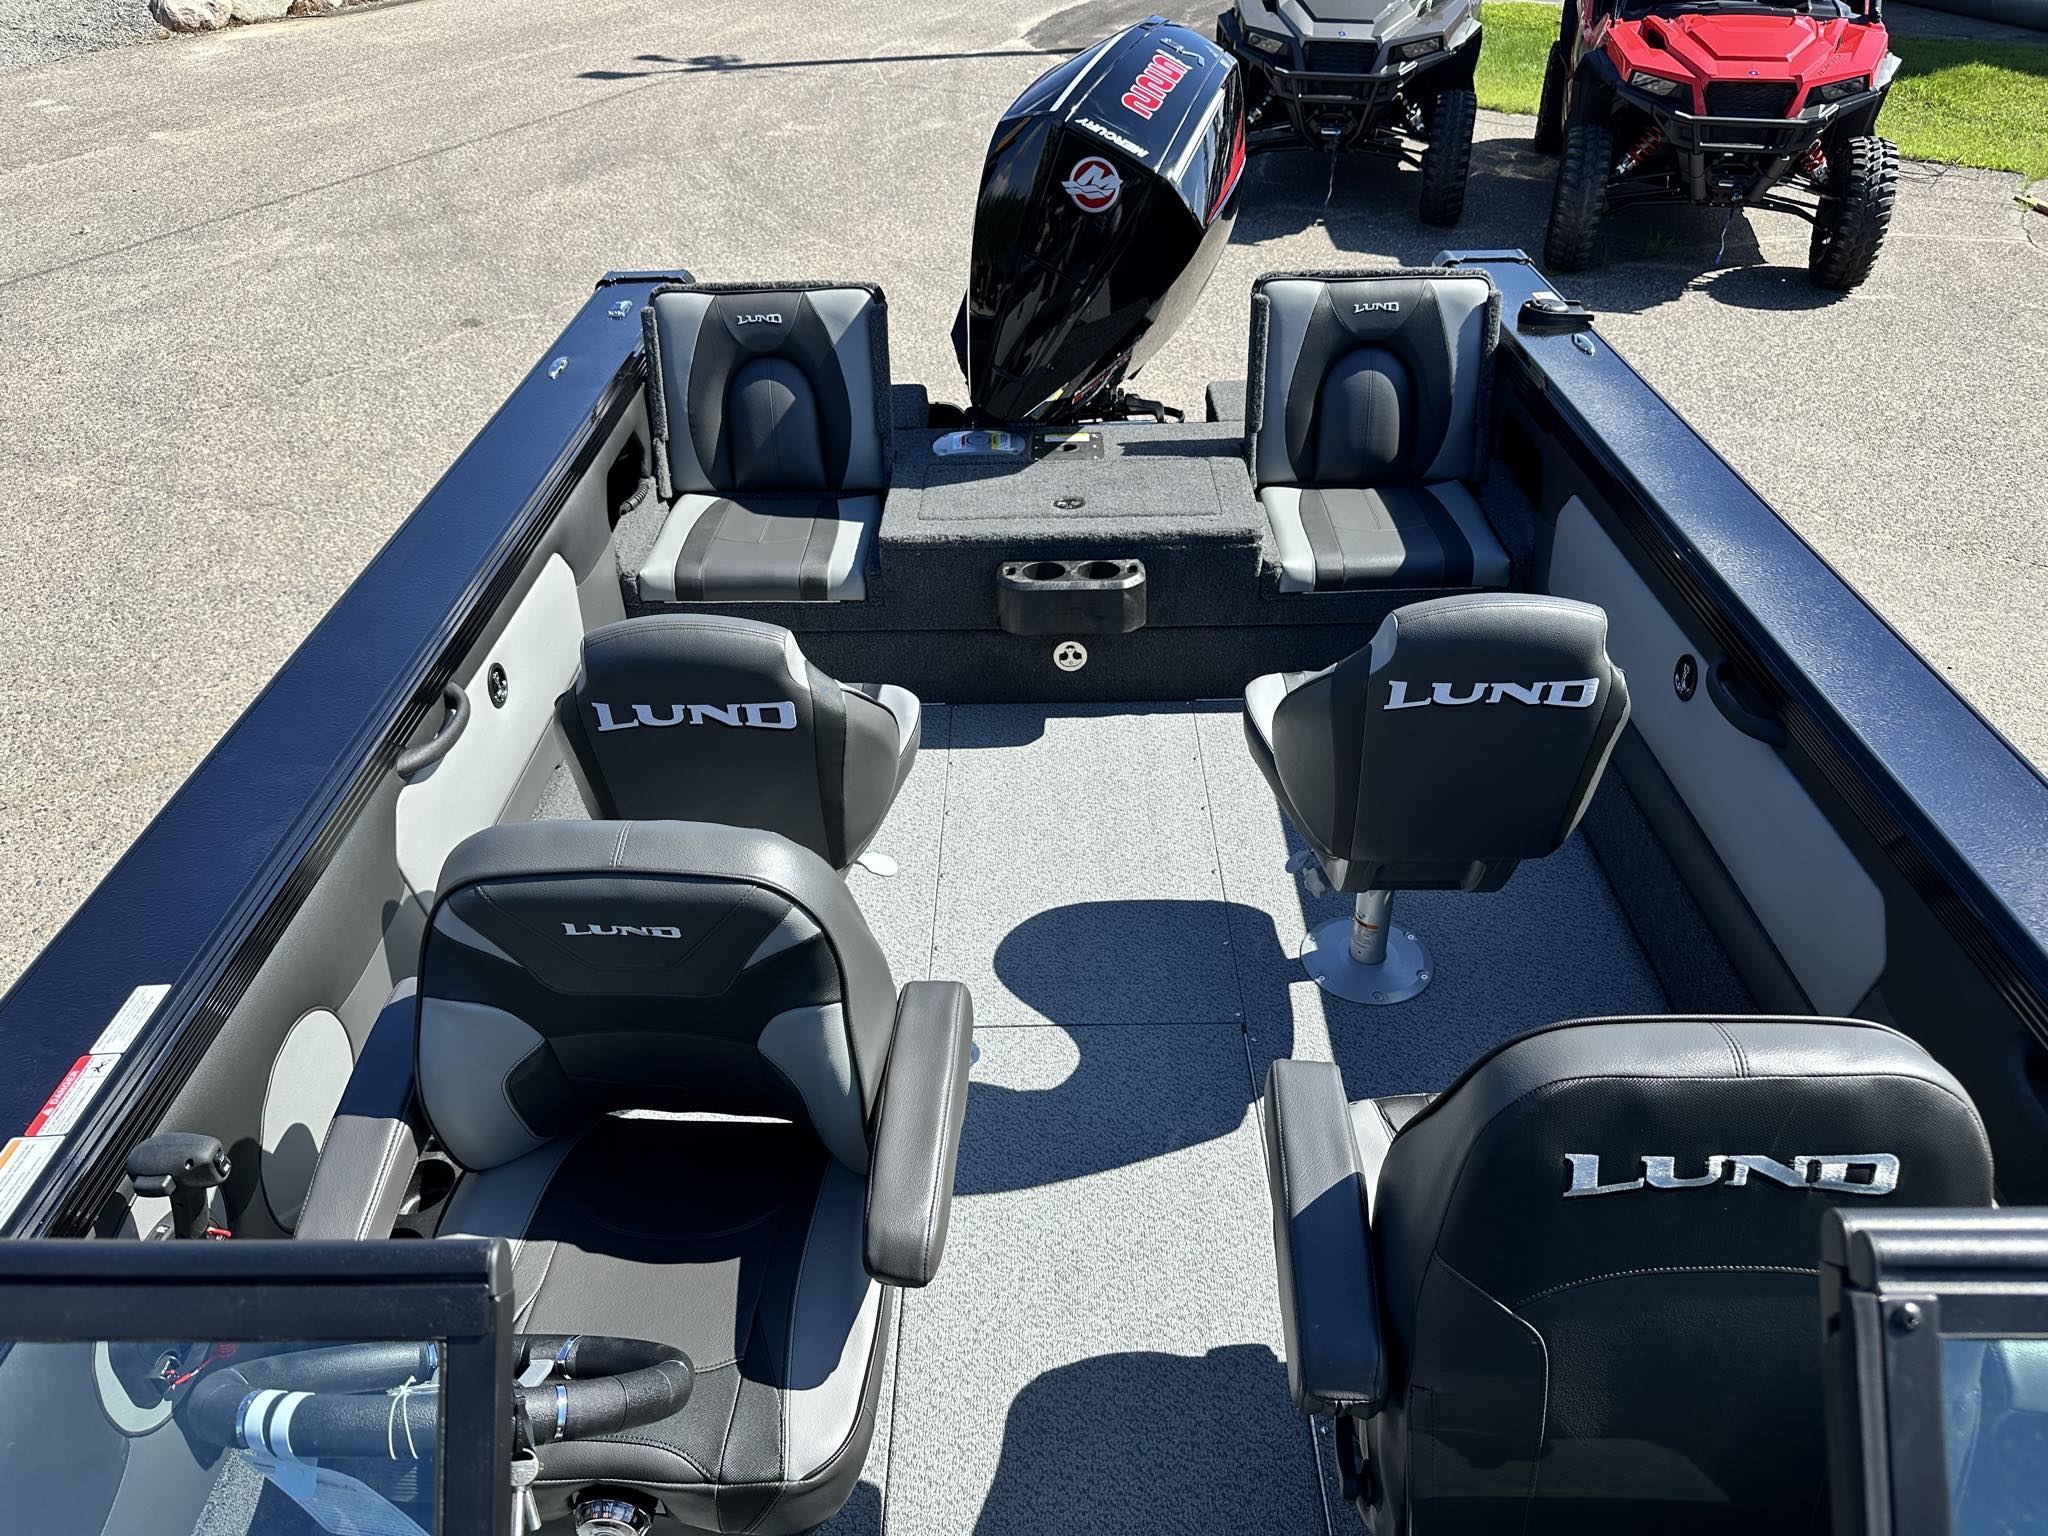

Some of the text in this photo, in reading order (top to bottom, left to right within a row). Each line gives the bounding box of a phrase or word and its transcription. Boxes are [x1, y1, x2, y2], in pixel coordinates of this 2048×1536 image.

[1076, 116, 1149, 158] MERCURY
[737, 314, 782, 325] LUND
[1353, 302, 1399, 313] LUND
[1383, 678, 1599, 710] LUND
[592, 701, 797, 732] LUND
[561, 923, 681, 938] LUND
[50, 1070, 80, 1106] DANGER
[1563, 1153, 1900, 1197] LUND
